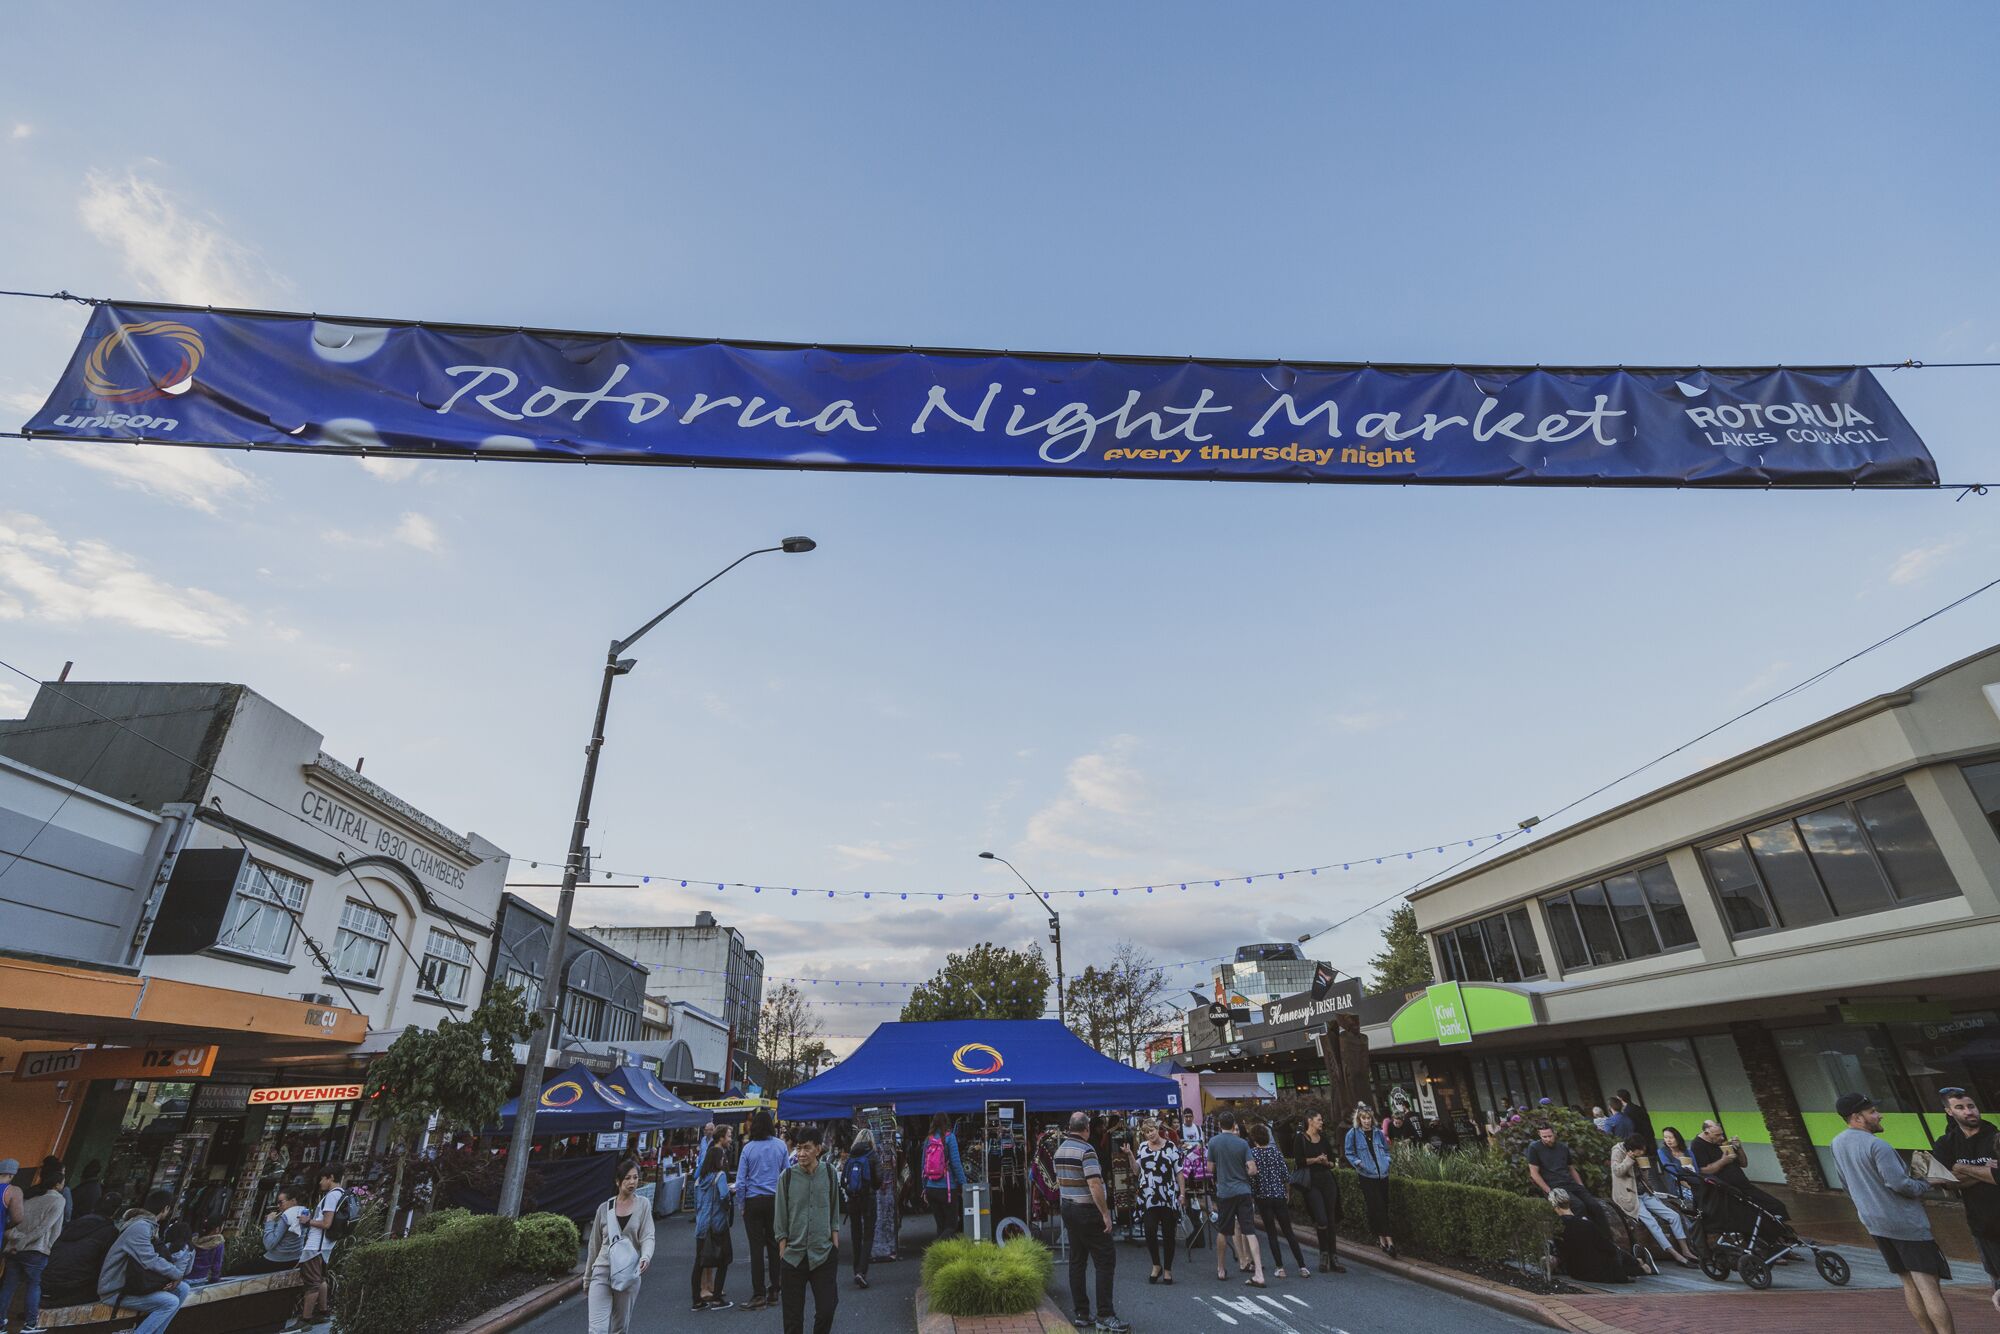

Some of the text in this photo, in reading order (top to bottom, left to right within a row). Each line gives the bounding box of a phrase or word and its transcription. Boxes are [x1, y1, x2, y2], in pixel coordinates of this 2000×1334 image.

[53, 409, 180, 432] unison
[436, 364, 1627, 464] Rotorua Night Market
[1685, 402, 1874, 428] ROTORUA
[1704, 428, 1889, 447] LAKES COUNCIL
[1104, 444, 1416, 468] every thursday night
[301, 791, 466, 890] CENTRAL 1930 CHAMBERS
[1269, 993, 1353, 1026] Hennessy's IRISH BAR
[1435, 1002, 1456, 1021] Kiwi
[30, 1054, 76, 1075] atm
[252, 1086, 360, 1102] SOUVENIRS
